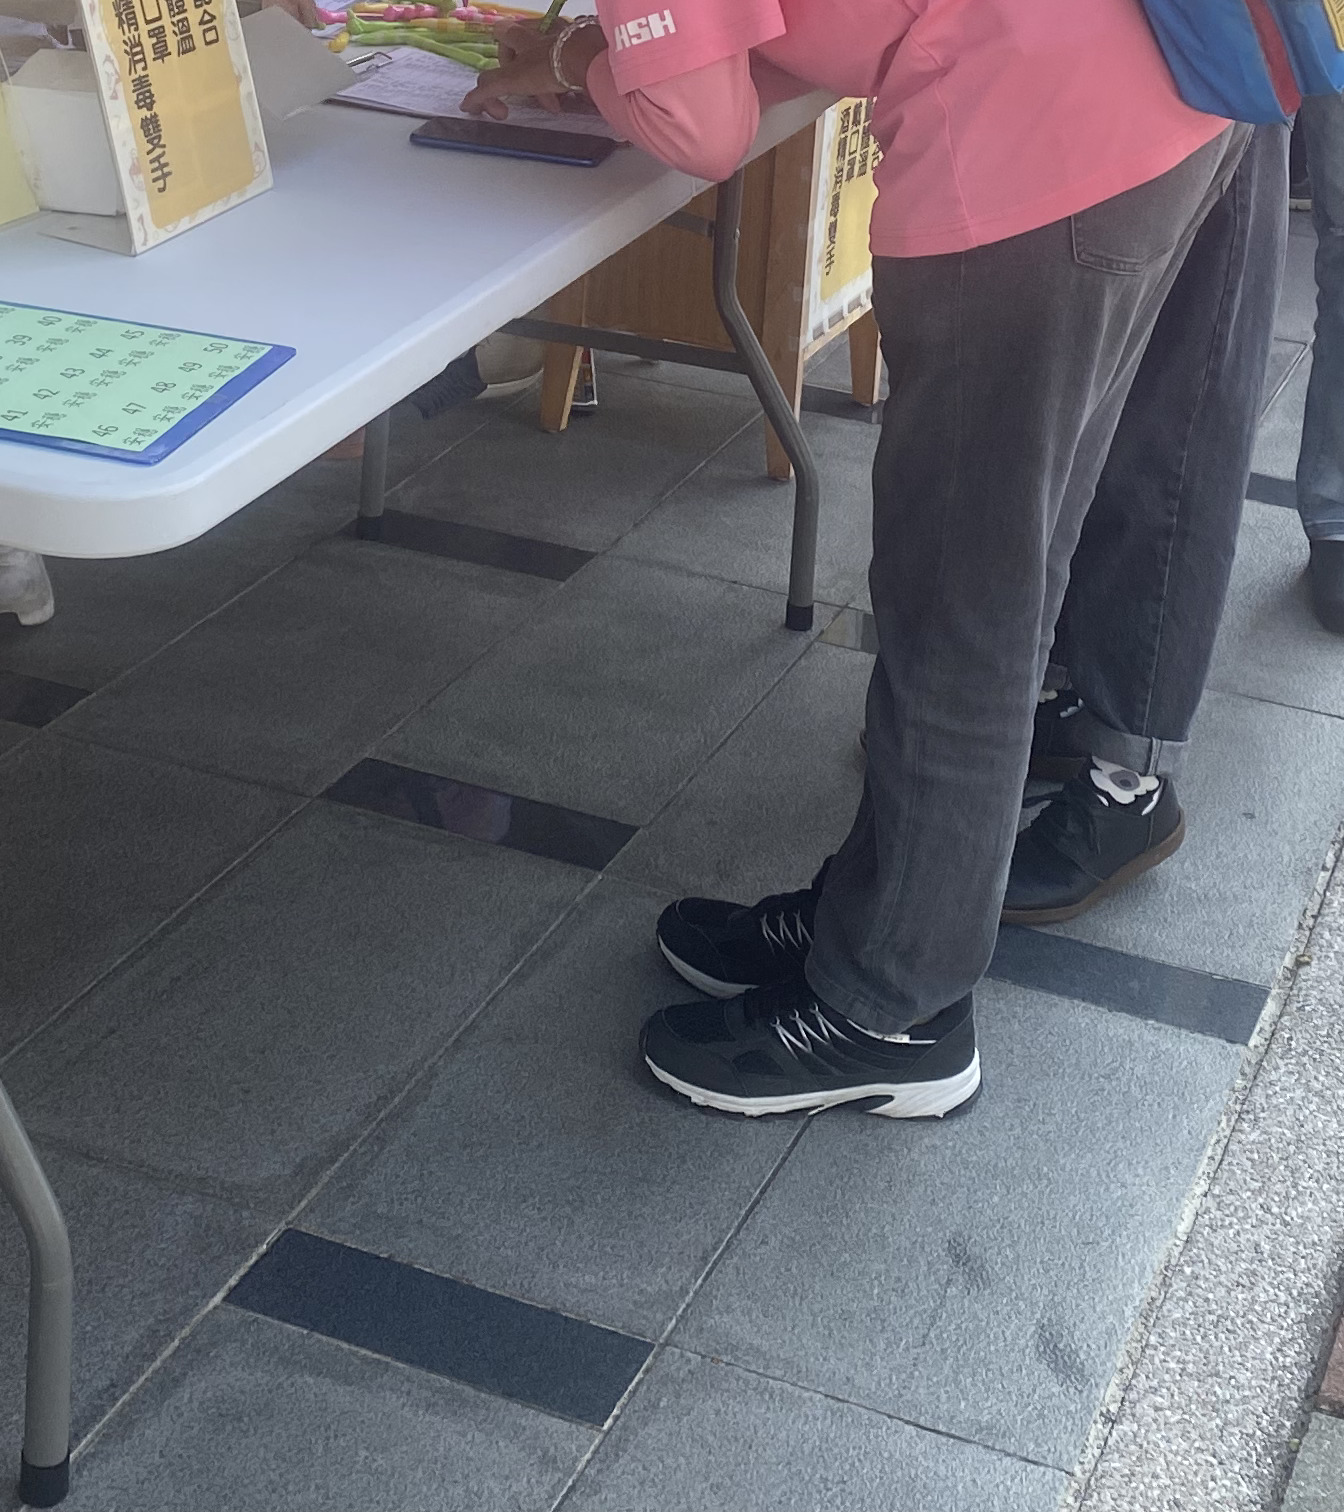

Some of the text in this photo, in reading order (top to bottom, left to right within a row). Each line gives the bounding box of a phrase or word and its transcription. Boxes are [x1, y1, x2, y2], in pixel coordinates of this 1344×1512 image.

[613, 8, 677, 53] HSH
[37, 315, 62, 326] 40
[5, 334, 32, 346] 39
[120, 329, 145, 340] 45
[89, 347, 115, 359] 44
[203, 342, 229, 354] 50
[59, 367, 86, 379] 43
[177, 361, 203, 373] 49
[150, 381, 177, 393] 48
[32, 388, 61, 400] 42
[121, 402, 147, 415] 47
[0, 409, 29, 422] 41
[92, 424, 119, 438] 46
